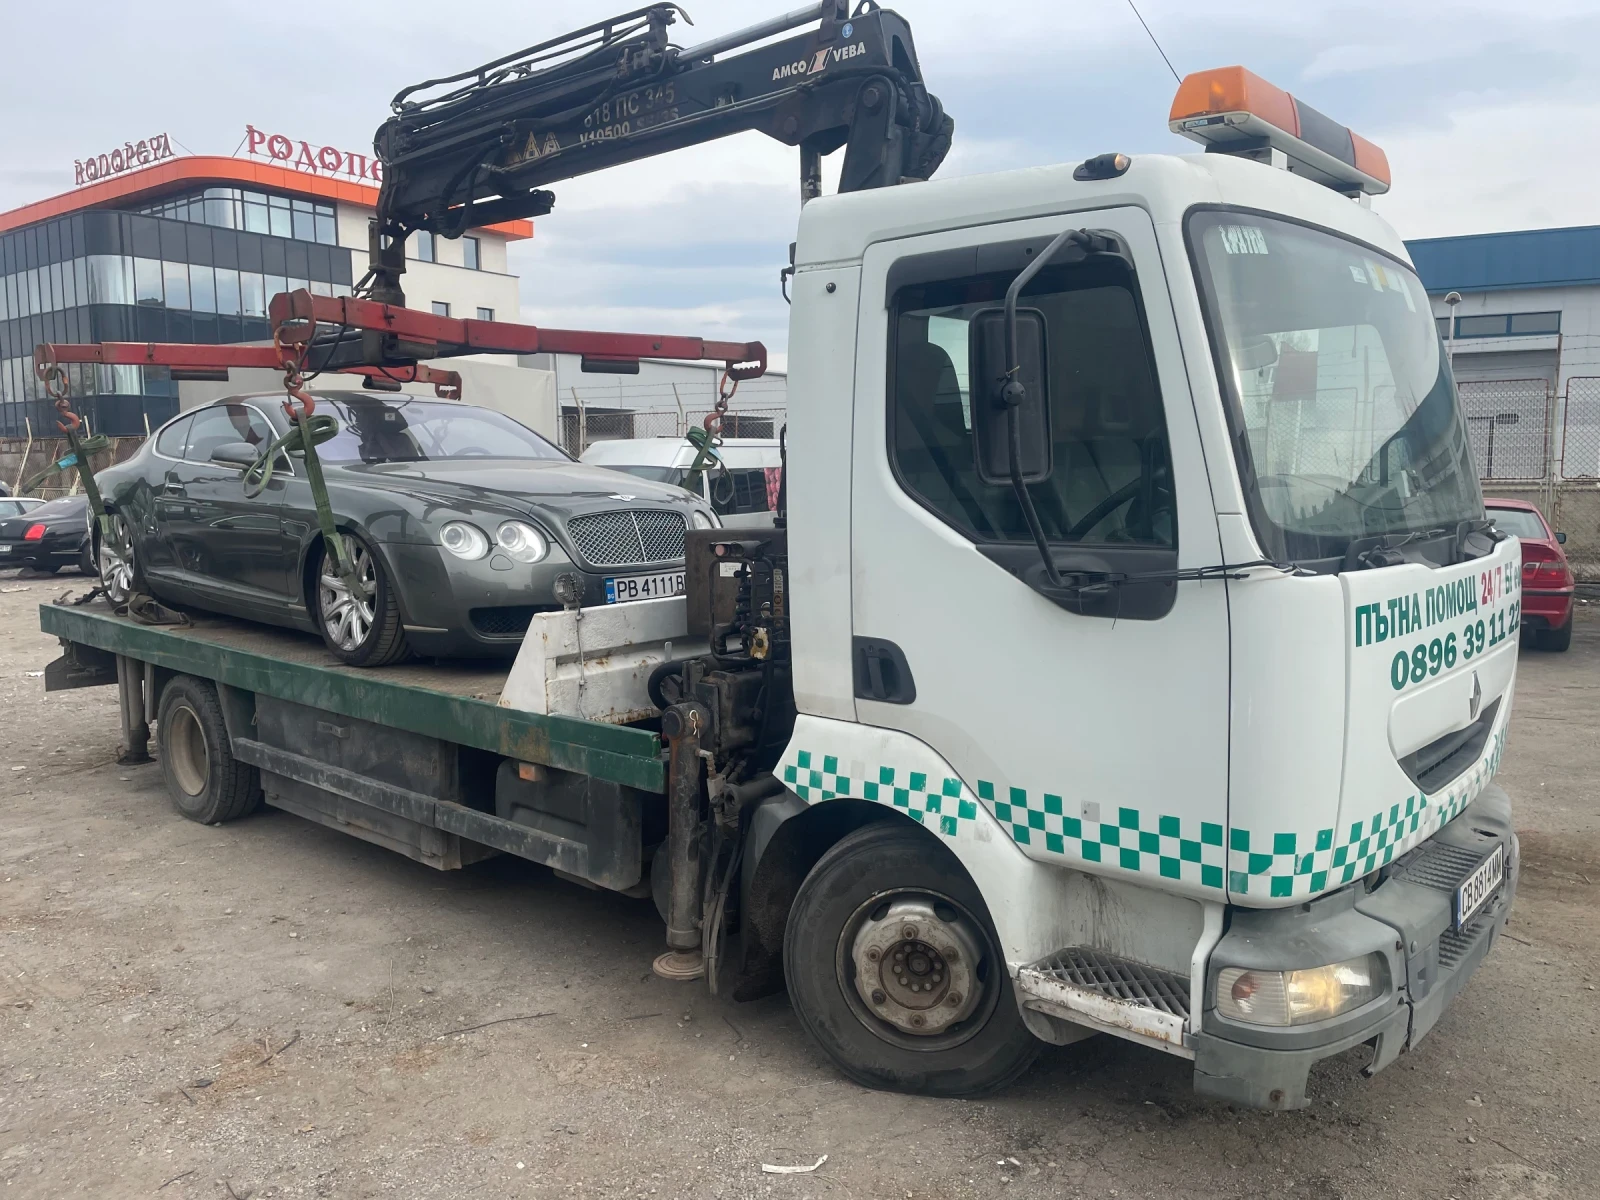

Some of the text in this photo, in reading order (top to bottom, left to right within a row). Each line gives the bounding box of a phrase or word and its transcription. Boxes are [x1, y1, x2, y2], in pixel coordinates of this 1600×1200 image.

[772, 42, 866, 80] AMCO VEBA
[74, 133, 174, 185] RODOPEYA
[1355, 593, 1422, 647] ПЪТНА
[1426, 575, 1478, 628] ПОМОЩ
[1481, 566, 1501, 608] 24/7
[1391, 599, 1520, 690] 0896 39 11 22
